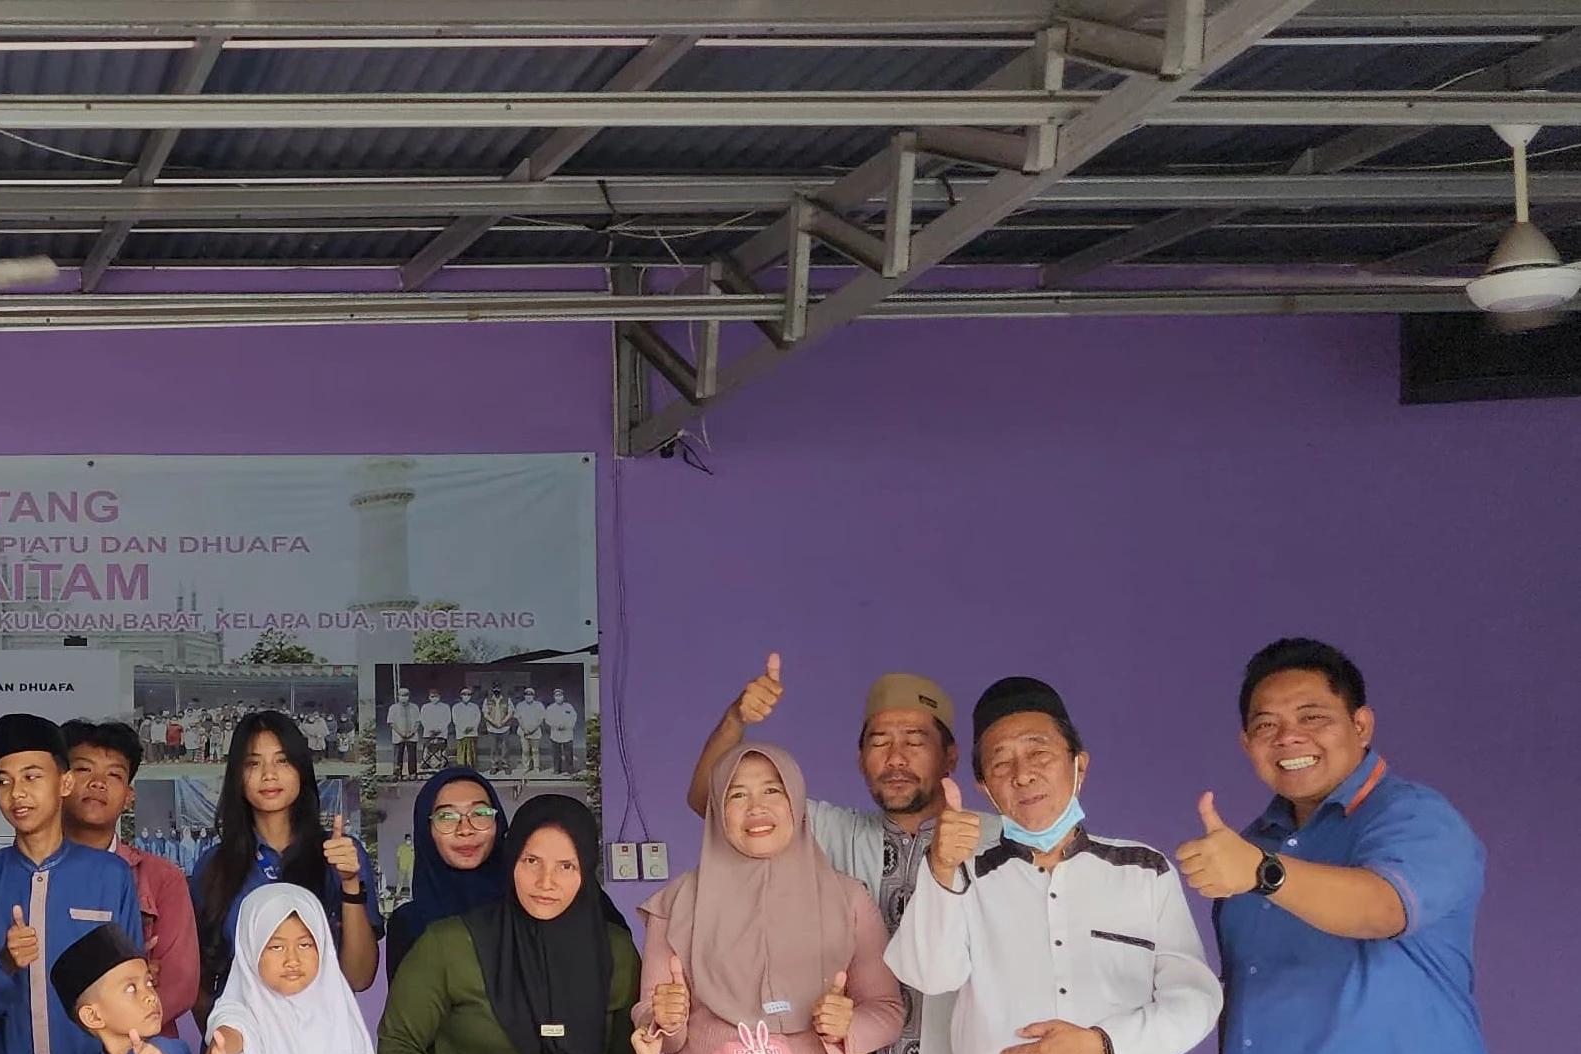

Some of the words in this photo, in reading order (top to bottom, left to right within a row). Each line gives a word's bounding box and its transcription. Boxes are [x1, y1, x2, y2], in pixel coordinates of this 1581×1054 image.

[101, 536, 167, 554] DAN
[178, 536, 311, 554] DHUAFA
[123, 613, 206, 632] BARAT,
[216, 613, 311, 630] KELAPA
[319, 612, 376, 632] DUA,
[382, 611, 535, 629] TANGERANG
[19, 682, 75, 692] DHUAFA
